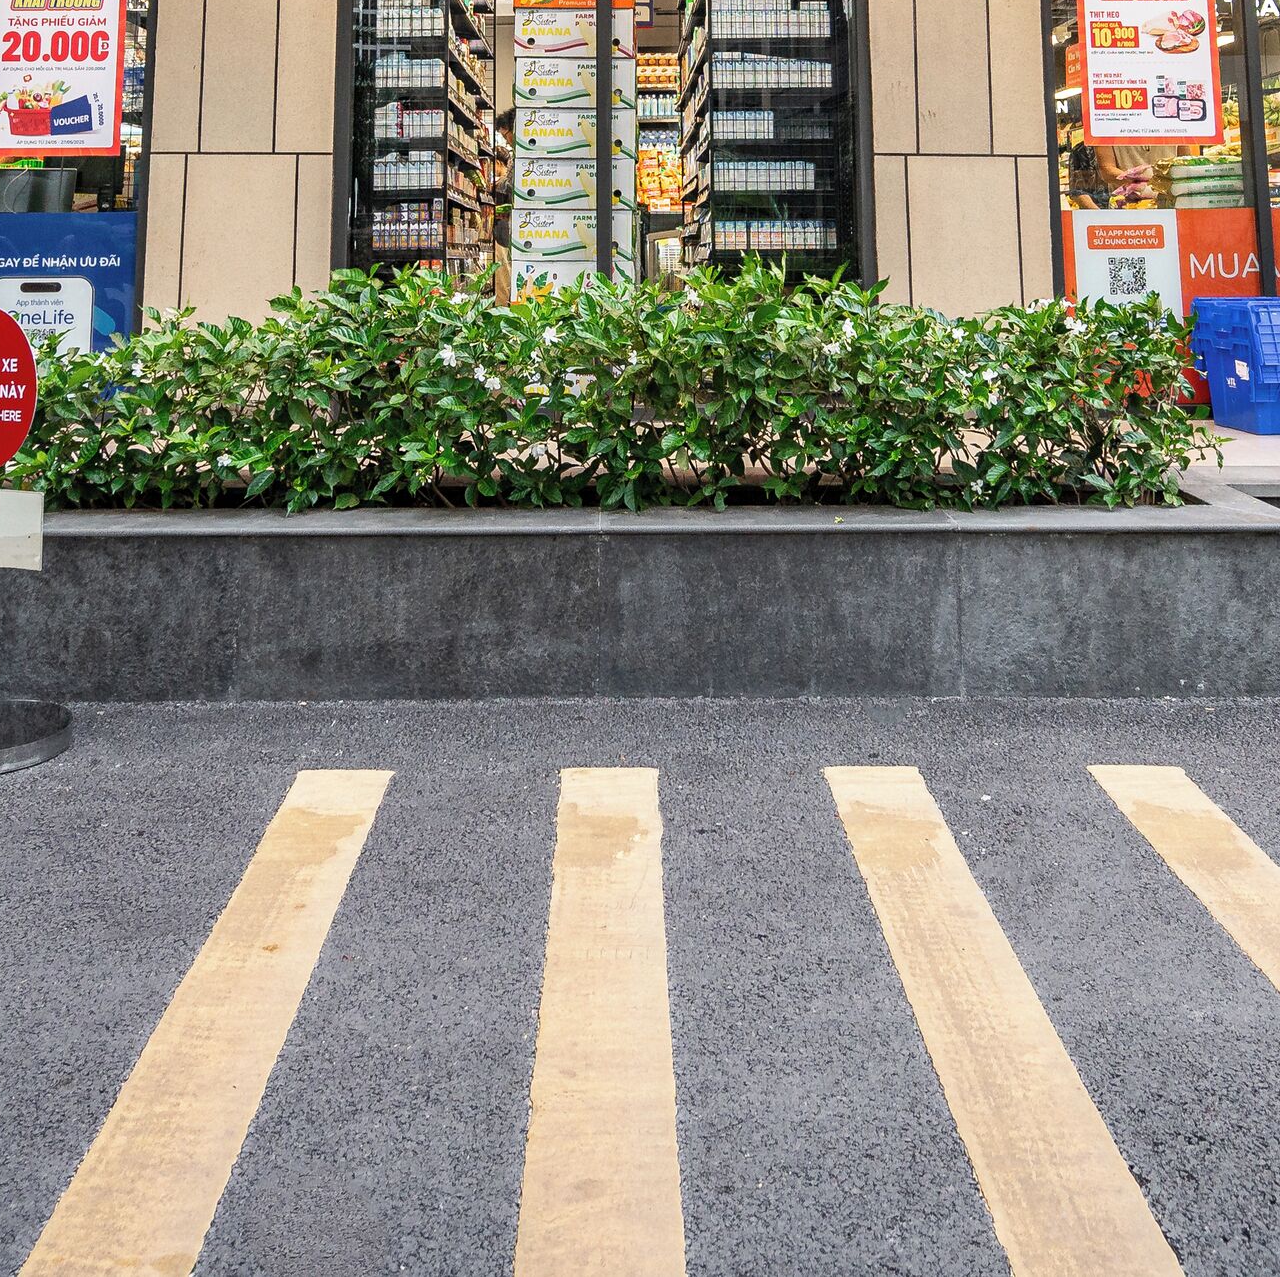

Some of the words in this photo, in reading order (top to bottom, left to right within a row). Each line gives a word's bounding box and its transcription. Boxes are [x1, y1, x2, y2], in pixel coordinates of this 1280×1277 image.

[1103, 11, 1120, 19] HEO
[8, 15, 38, 29] TẶNG
[41, 14, 75, 27] PHIẾU
[78, 14, 107, 27] GIẢM
[521, 27, 572, 36] BANANA
[1092, 27, 1135, 48] 10.900
[523, 78, 574, 87] BANANA
[1112, 89, 1144, 109] 10%
[53, 114, 90, 127] VOUCHER
[523, 128, 574, 137] BANANA
[521, 178, 573, 188] BANANA
[518, 230, 570, 239] BANANA
[1094, 228, 1106, 237] TẢI
[1108, 229, 1123, 237] APP
[1146, 227, 1156, 236] ĐỂ
[1105, 238, 1127, 246] DỤNG
[1128, 238, 1146, 246] DỊCH
[1147, 238, 1159, 246] VỤ
[23, 253, 39, 269] ĐỂ
[42, 255, 77, 271] NHẬN
[80, 256, 97, 268] ƯU
[99, 254, 121, 268] ĐÃI
[1189, 252, 1263, 279] MUA
[15, 299, 28, 308] App
[29, 298, 48, 307] thành
[50, 298, 64, 307] viên
[1, 358, 19, 373] XE
[0, 380, 27, 400] NÀY
